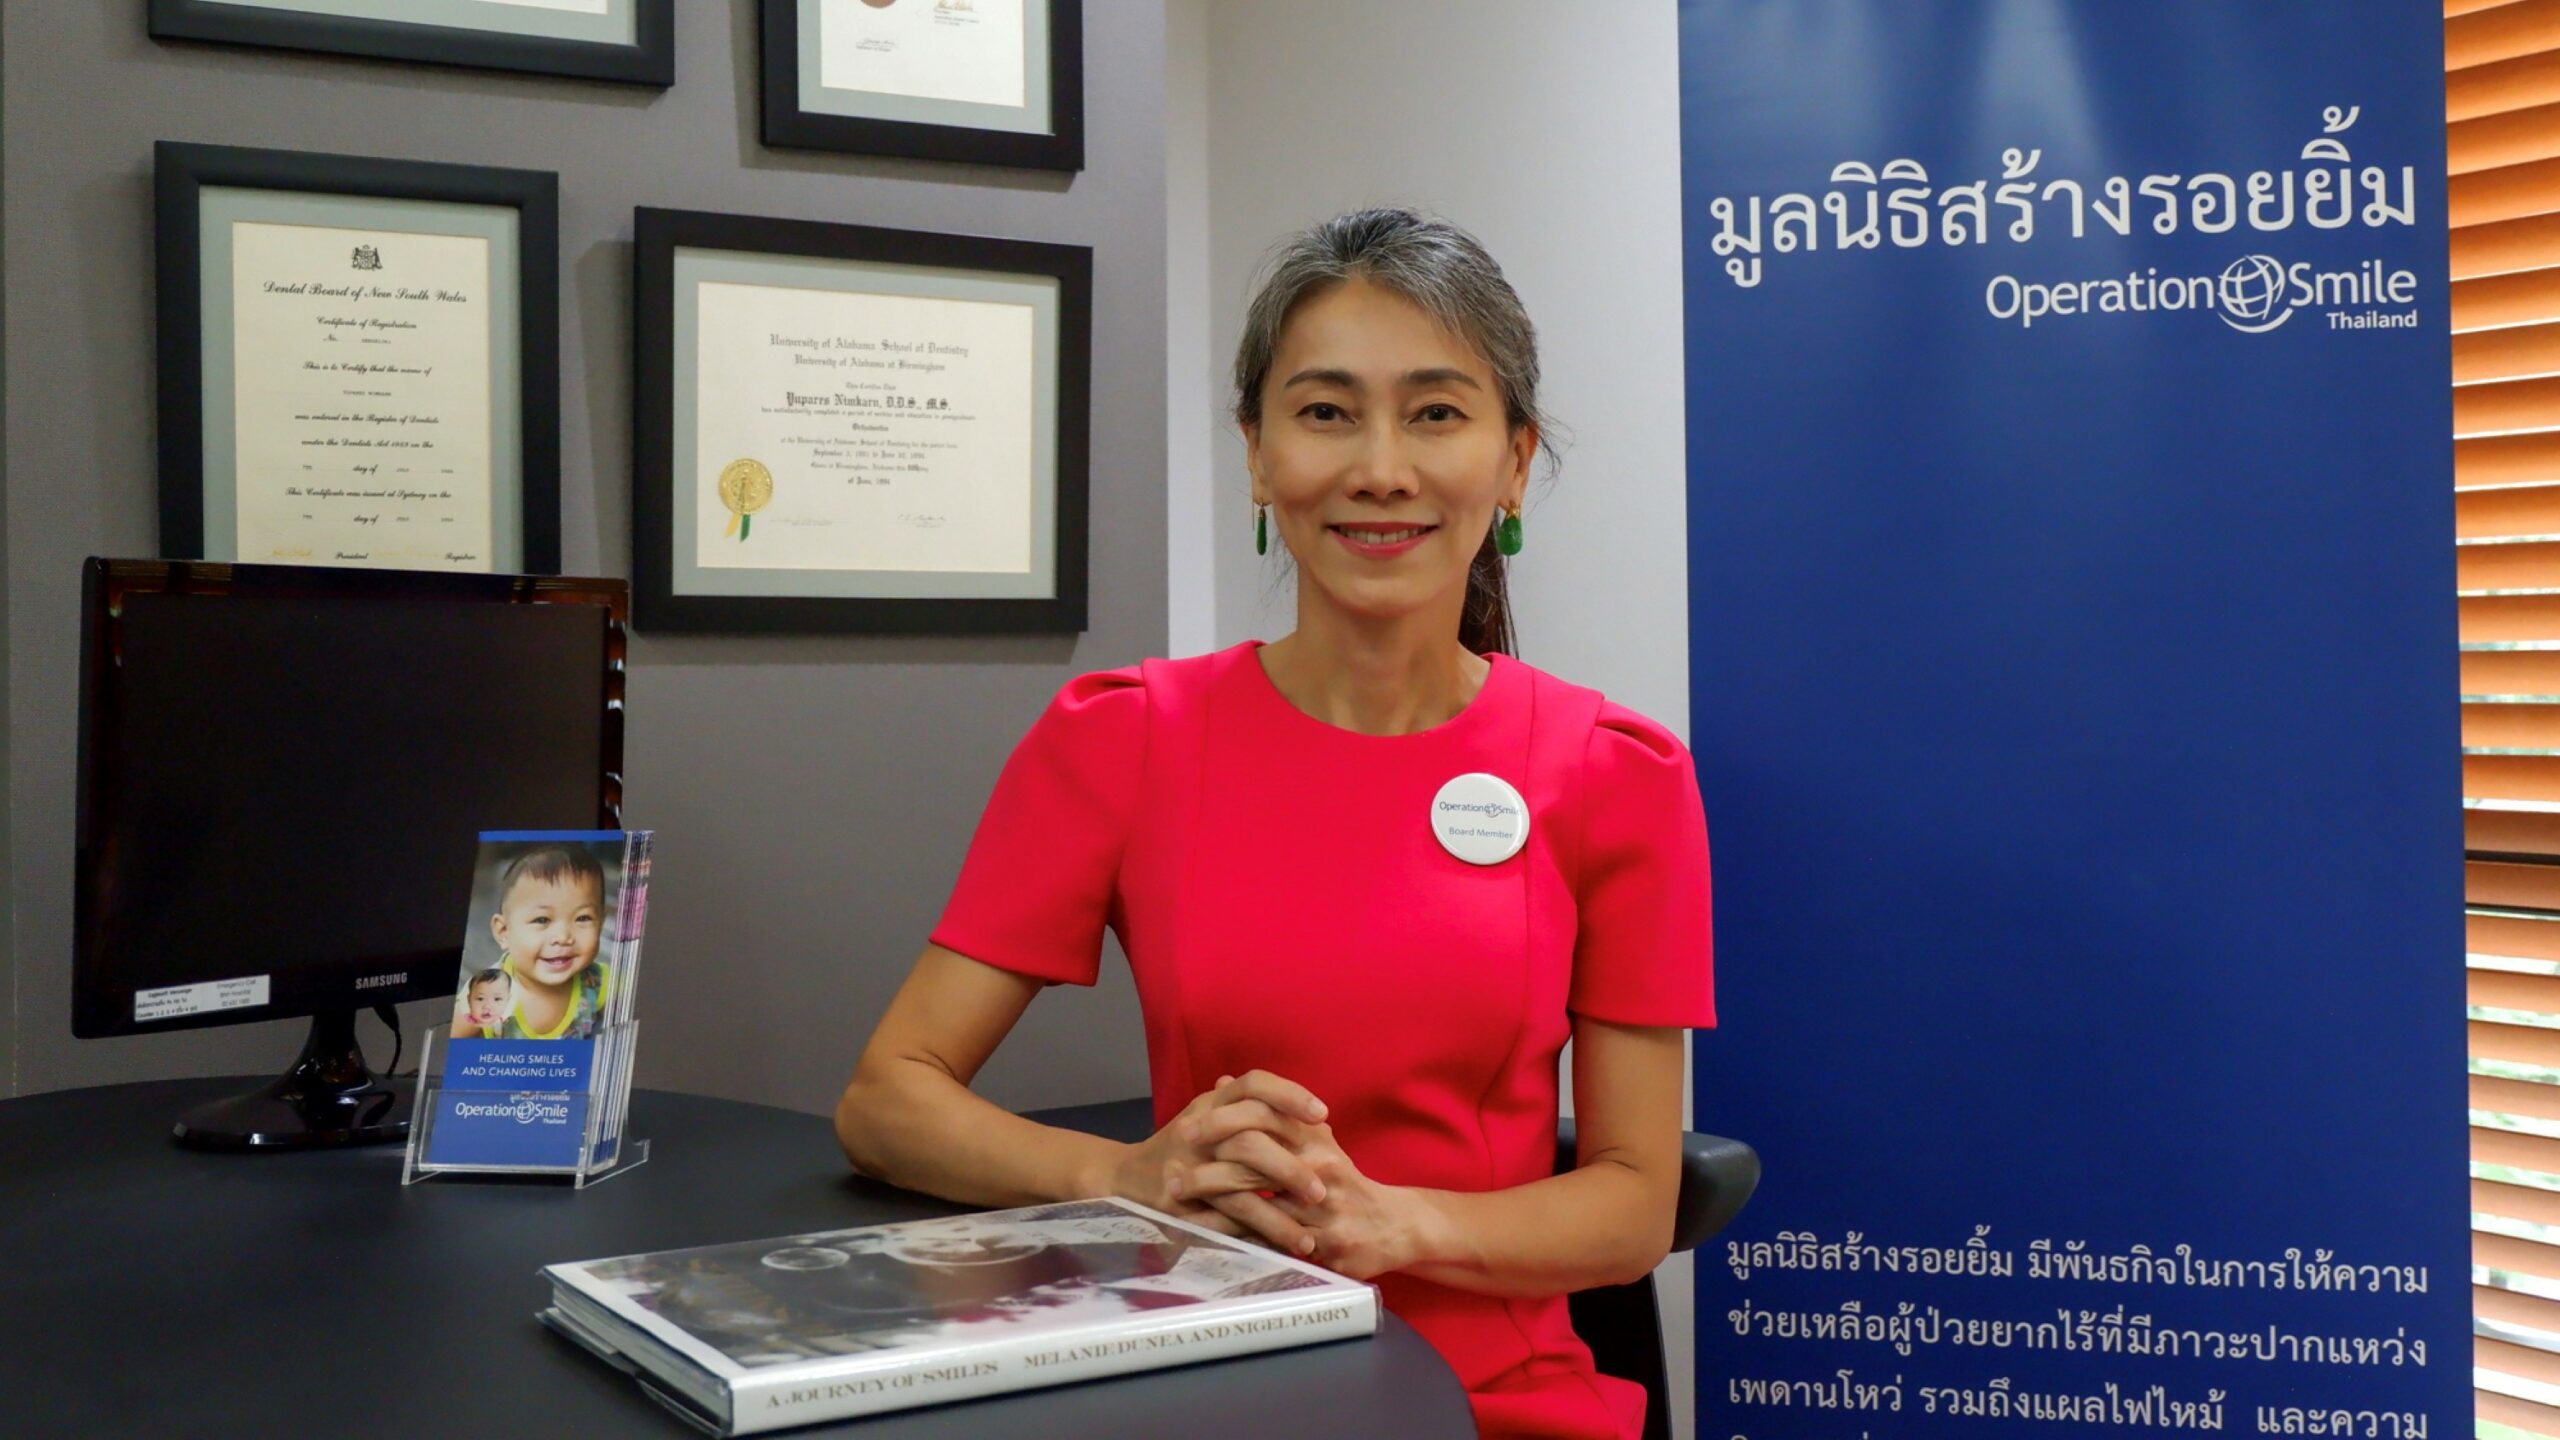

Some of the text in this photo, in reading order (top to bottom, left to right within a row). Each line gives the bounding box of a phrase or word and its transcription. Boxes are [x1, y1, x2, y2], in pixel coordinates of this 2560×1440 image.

[1710, 106, 2416, 288] มูลนิธิสร้างรอยยิ้ม
[263, 281, 467, 303] Dental Board of New South Wales
[1986, 260, 2417, 328] Operation Smile
[2327, 310, 2417, 329] Thailand
[770, 334, 819, 350] University
[822, 338, 831, 349] of
[834, 337, 876, 350] Alabama
[881, 339, 913, 353] School
[915, 342, 924, 353] of
[1439, 801, 1485, 812] Operation
[1449, 827, 1514, 839] Board Member
[355, 972, 408, 989] SAMSUNG
[479, 1054, 564, 1064] HEALING SMILES
[462, 1067, 577, 1078] AND CHANGING LIVES
[455, 1102, 568, 1119] Operation Smile
[1727, 1224, 2428, 1294] มูลนิธิสร้างรอยยิ้ม มีพันธกิจในการให้ความ
[1024, 1305, 1353, 1369] MELANIE DUNEA AND NIGEL PARRY
[1728, 1299, 2426, 1366] ช่วยเหลือผู้ป่วยยากไร้ที่มีภาวะปากแหว่ง
[767, 1360, 1000, 1409] A JOURNEY OF SMILES
[1730, 1369, 2428, 1440] เพดานโหว่ รวมถึงแผลไฟไหม้ และความ
